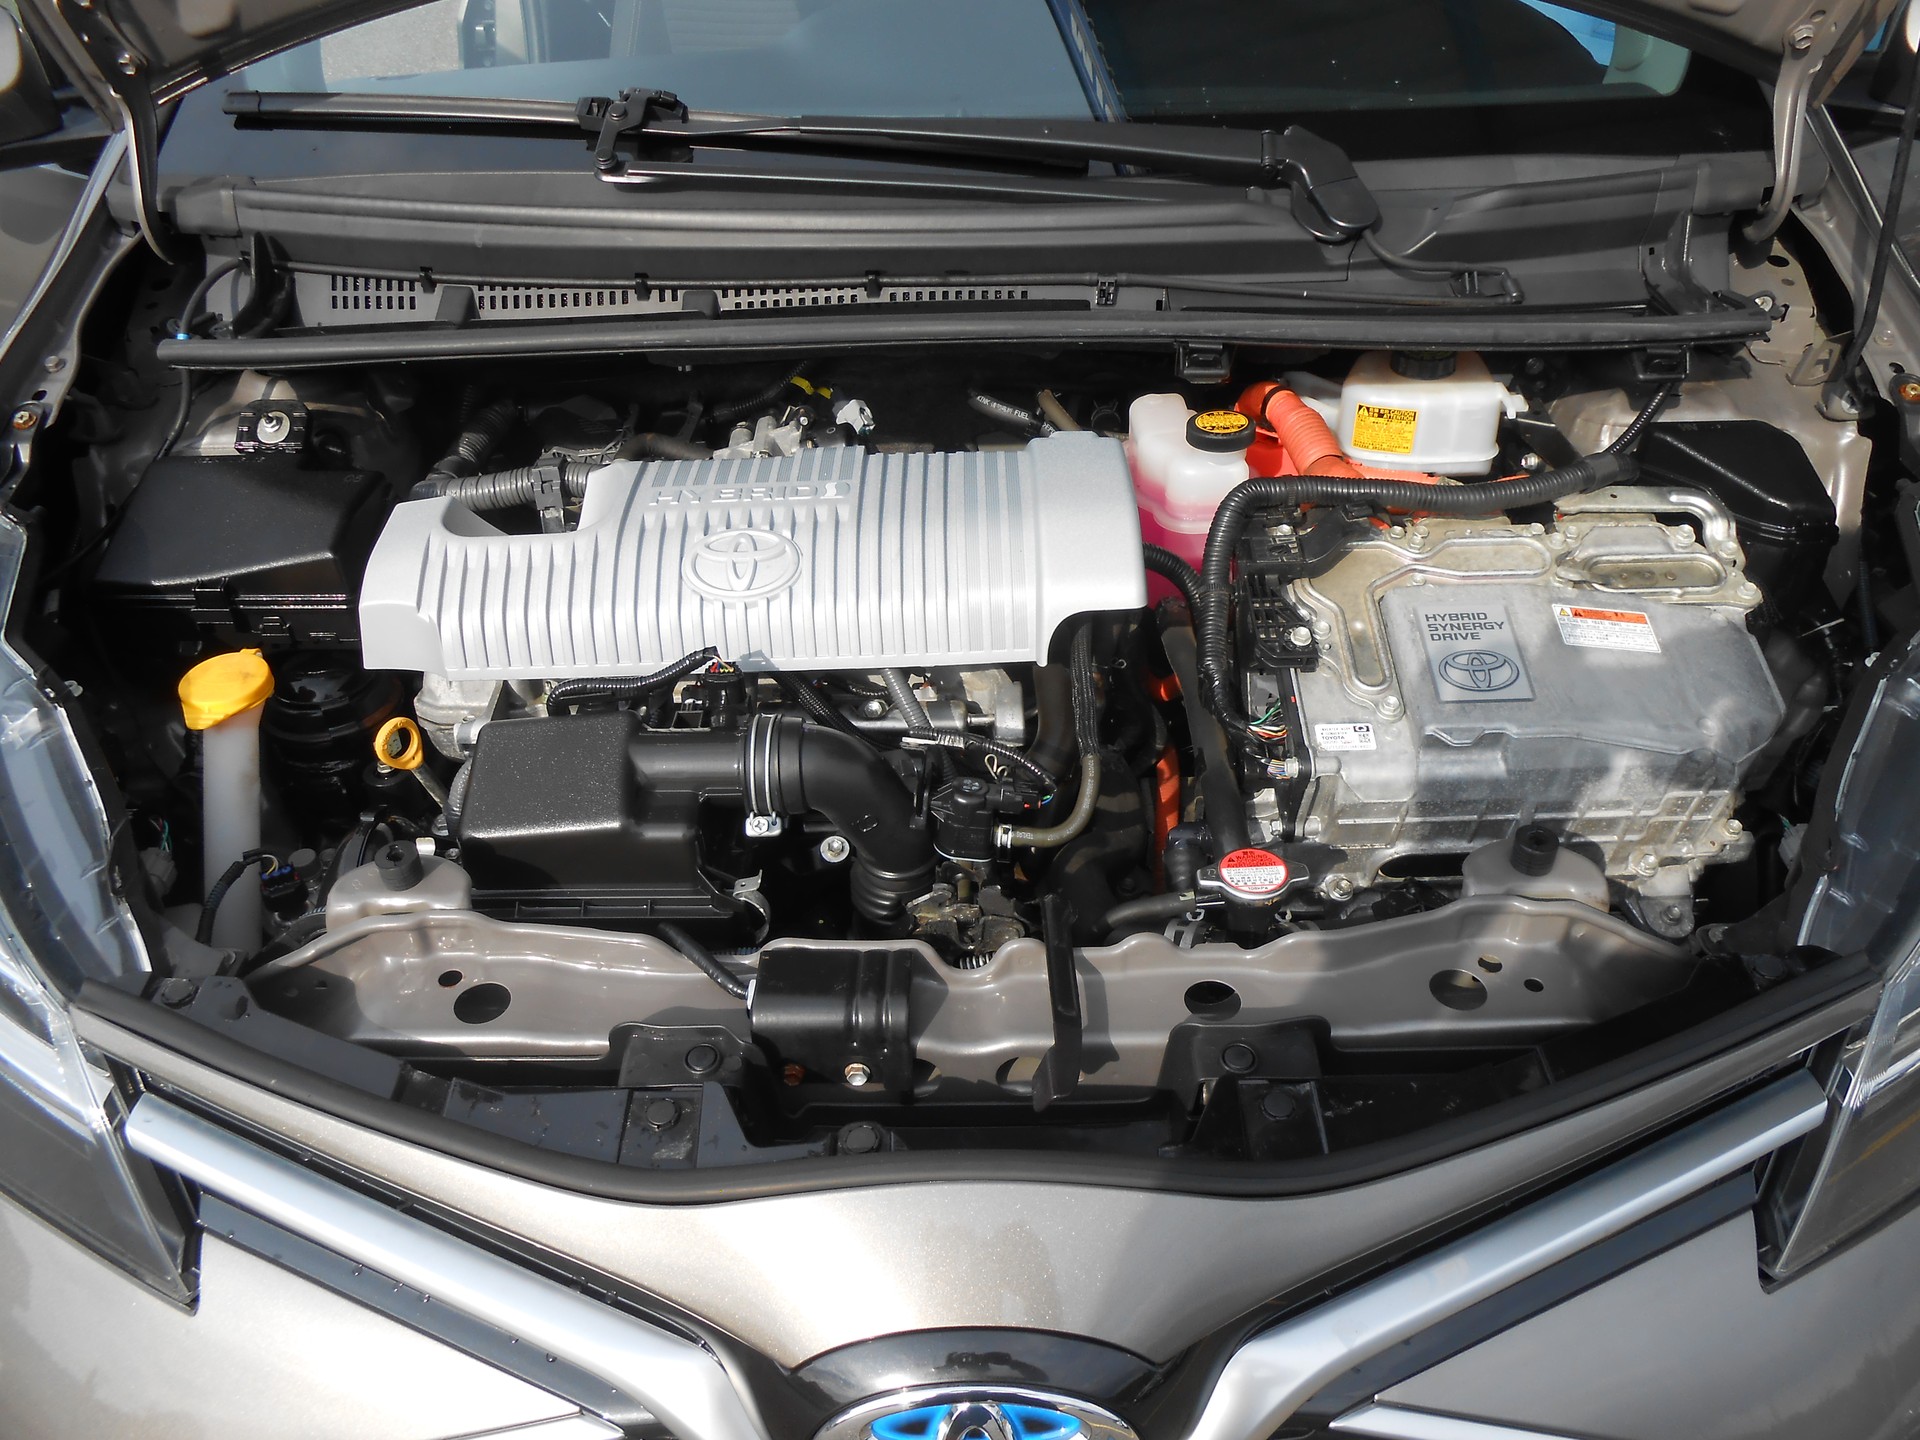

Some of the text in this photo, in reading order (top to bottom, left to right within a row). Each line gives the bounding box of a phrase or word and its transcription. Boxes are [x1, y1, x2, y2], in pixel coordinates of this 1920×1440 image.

[1014, 409, 1030, 421] FUEL
[649, 486, 818, 505] HYBRID
[1425, 612, 1488, 622] HYBRID
[1427, 621, 1504, 632] SYNERGY
[1430, 632, 1481, 641] DRIVE
